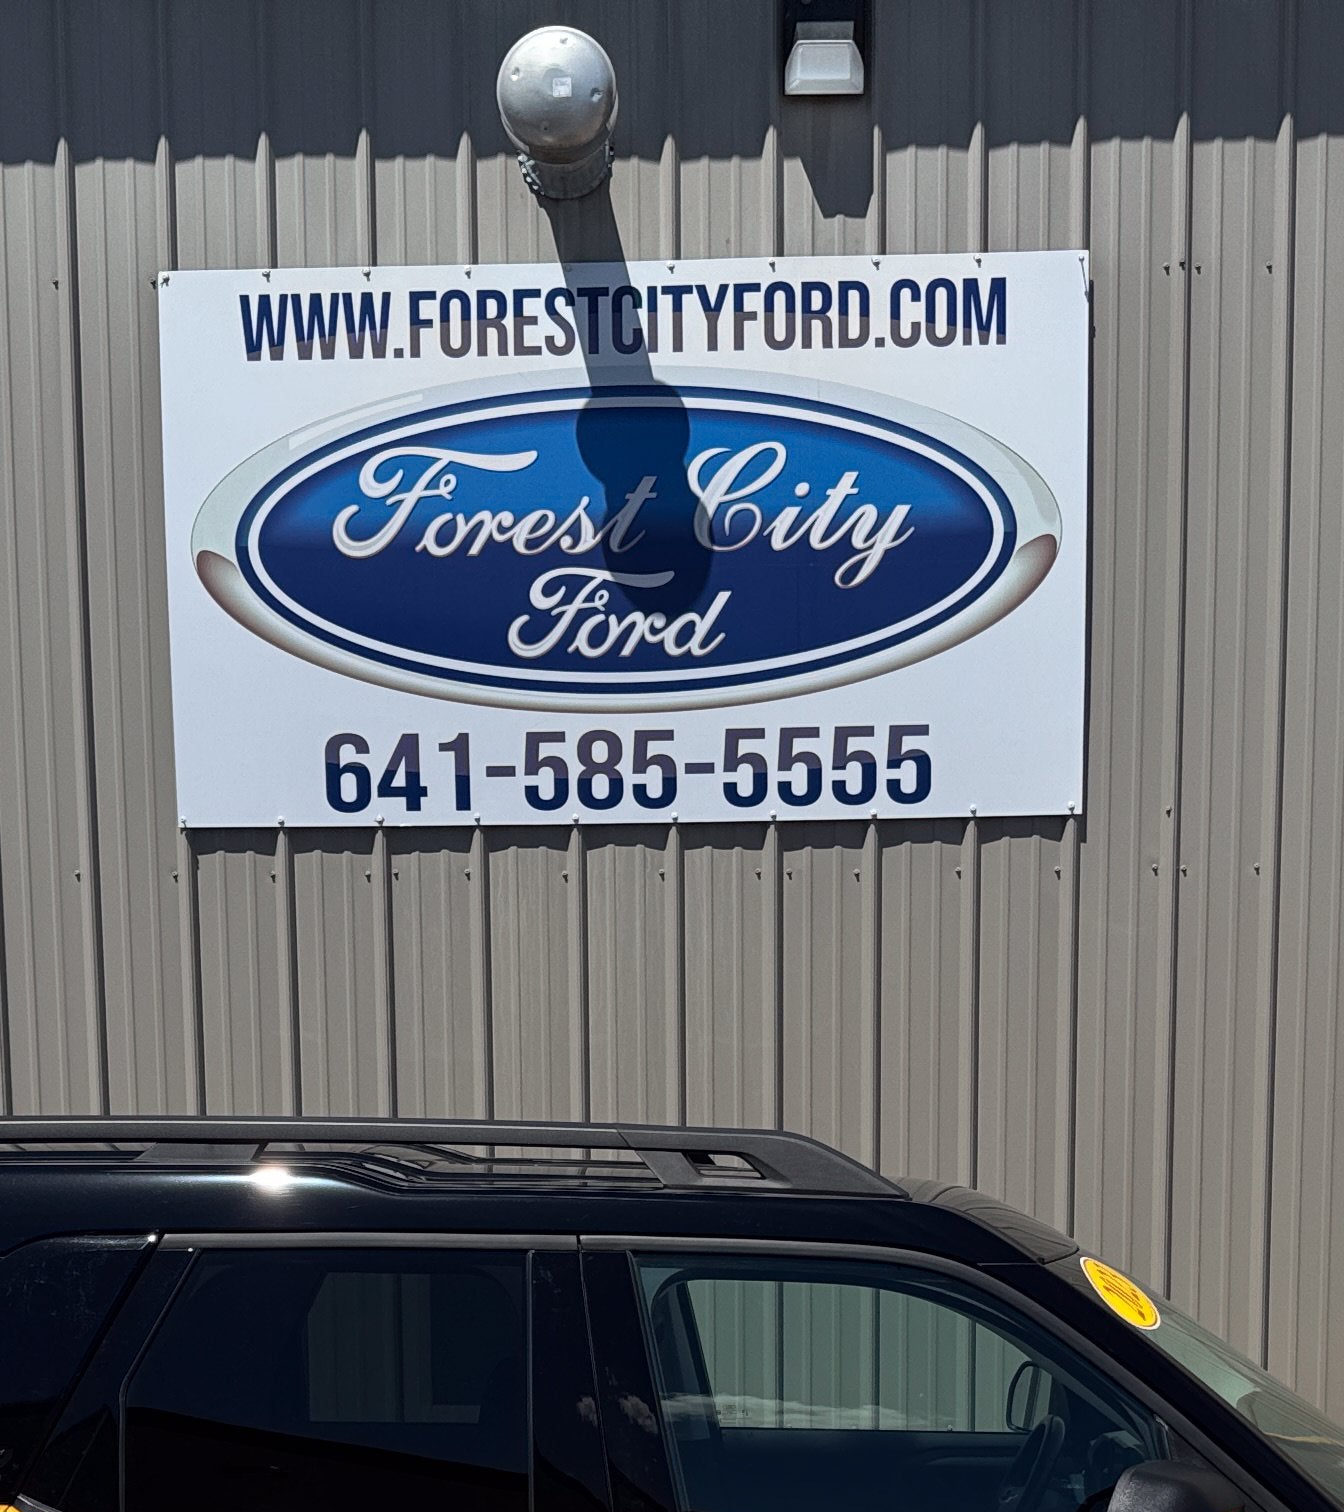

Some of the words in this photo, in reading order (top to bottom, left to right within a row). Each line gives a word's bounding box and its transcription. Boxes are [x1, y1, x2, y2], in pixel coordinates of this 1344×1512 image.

[239, 277, 1008, 362] WWW.FORESTCITYFORD.COM
[332, 445, 658, 558] Forest
[687, 440, 915, 590] City
[507, 567, 733, 659] Ford
[324, 723, 933, 814] 641-585-5555
